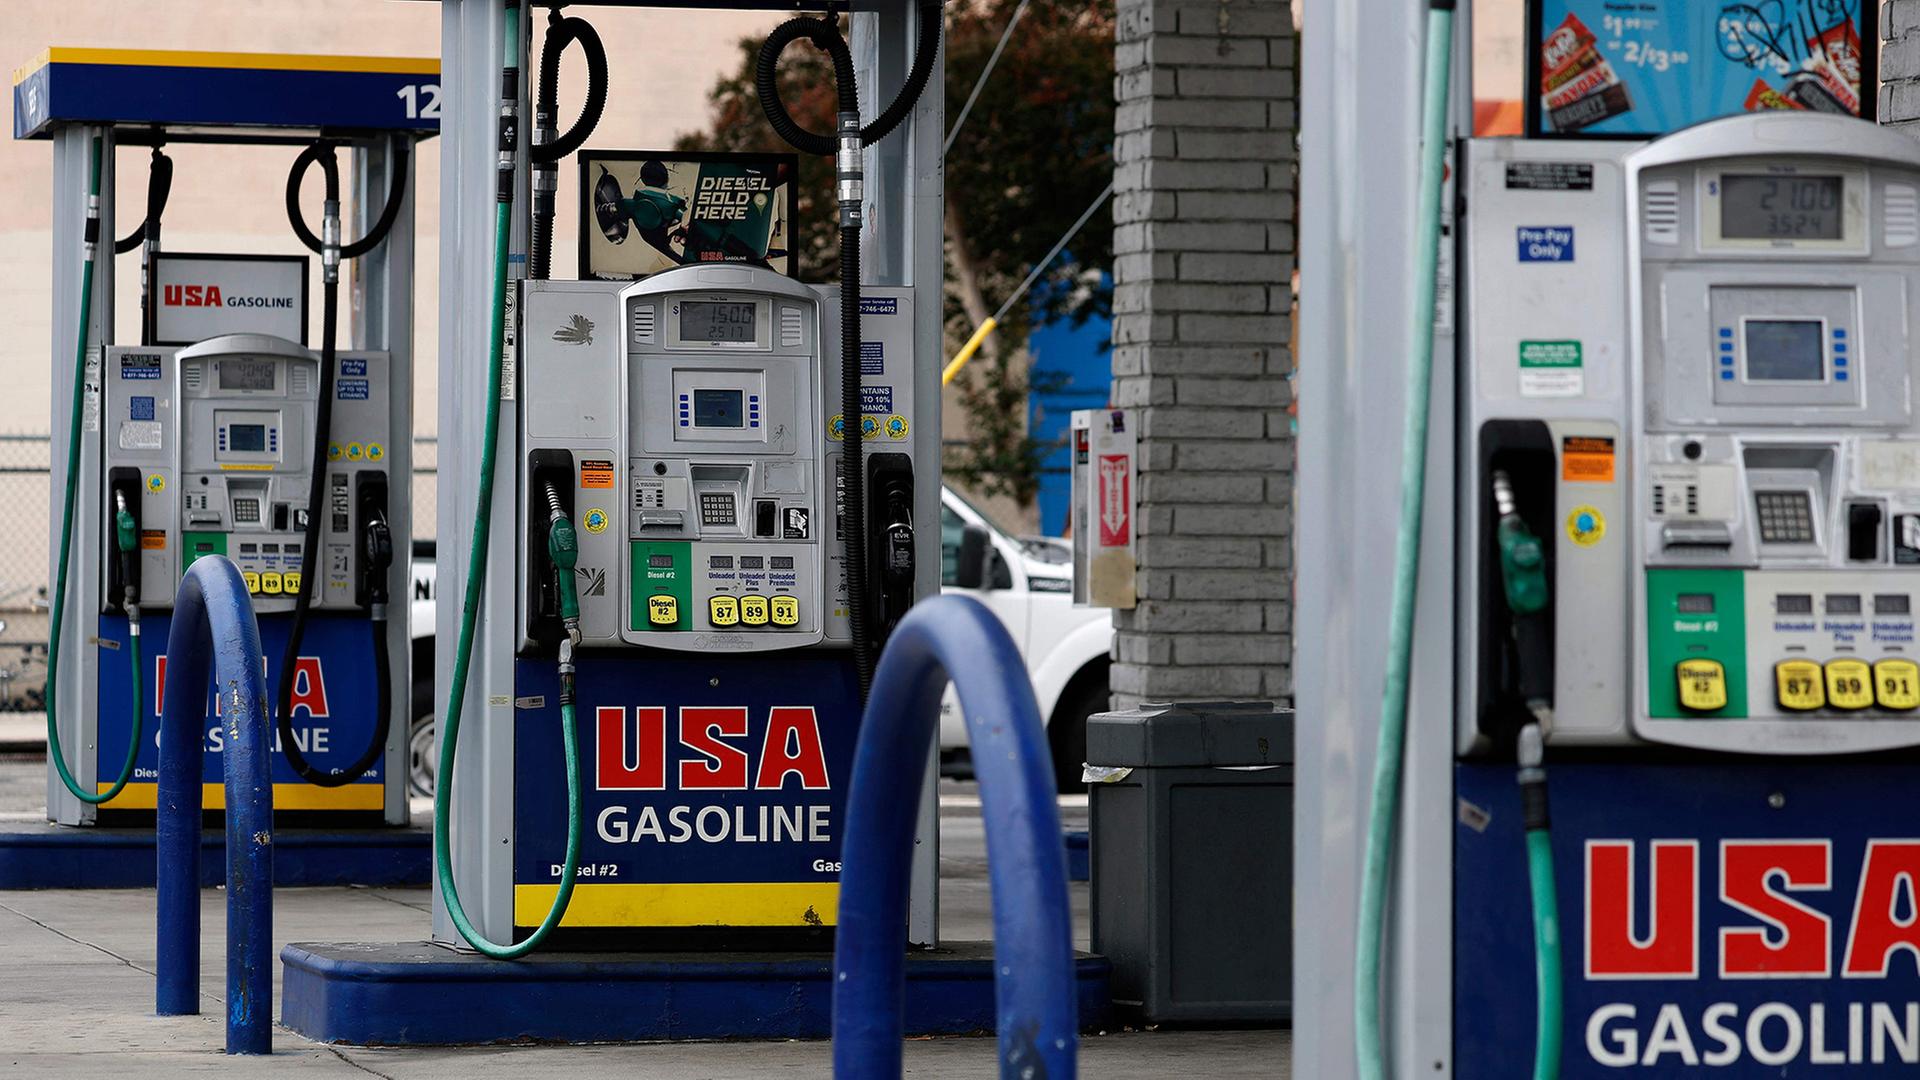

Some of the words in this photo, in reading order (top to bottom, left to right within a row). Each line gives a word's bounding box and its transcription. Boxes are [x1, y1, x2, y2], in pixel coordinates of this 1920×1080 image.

[396, 85, 441, 119] 12
[700, 177, 771, 191] DIESEL
[697, 192, 750, 205] SOLD
[694, 207, 748, 220] HERE
[1520, 229, 1570, 246] Pre-Pay
[700, 251, 724, 261] USA
[1529, 243, 1562, 260] Only
[164, 284, 223, 307] USA
[227, 296, 293, 309] GASOLINE
[860, 305, 896, 314] 7-746-6472
[861, 404, 888, 412] HANOL
[265, 579, 278, 588] 89
[287, 579, 299, 588] 91
[651, 599, 675, 608] Diesel
[658, 608, 669, 616] #2
[716, 607, 733, 618] 87
[746, 606, 763, 617] 89
[776, 606, 793, 618] 91
[1787, 678, 1812, 695] 87
[1836, 678, 1861, 695] 89
[1885, 678, 1909, 696] 91
[596, 706, 831, 791] USA
[135, 768, 158, 778] Dies
[597, 805, 831, 843] GASOLINE
[550, 863, 596, 877] Disel
[599, 864, 618, 877] #2
[1584, 839, 1920, 980] USA
[1585, 1002, 1920, 1066] GASOLIN
